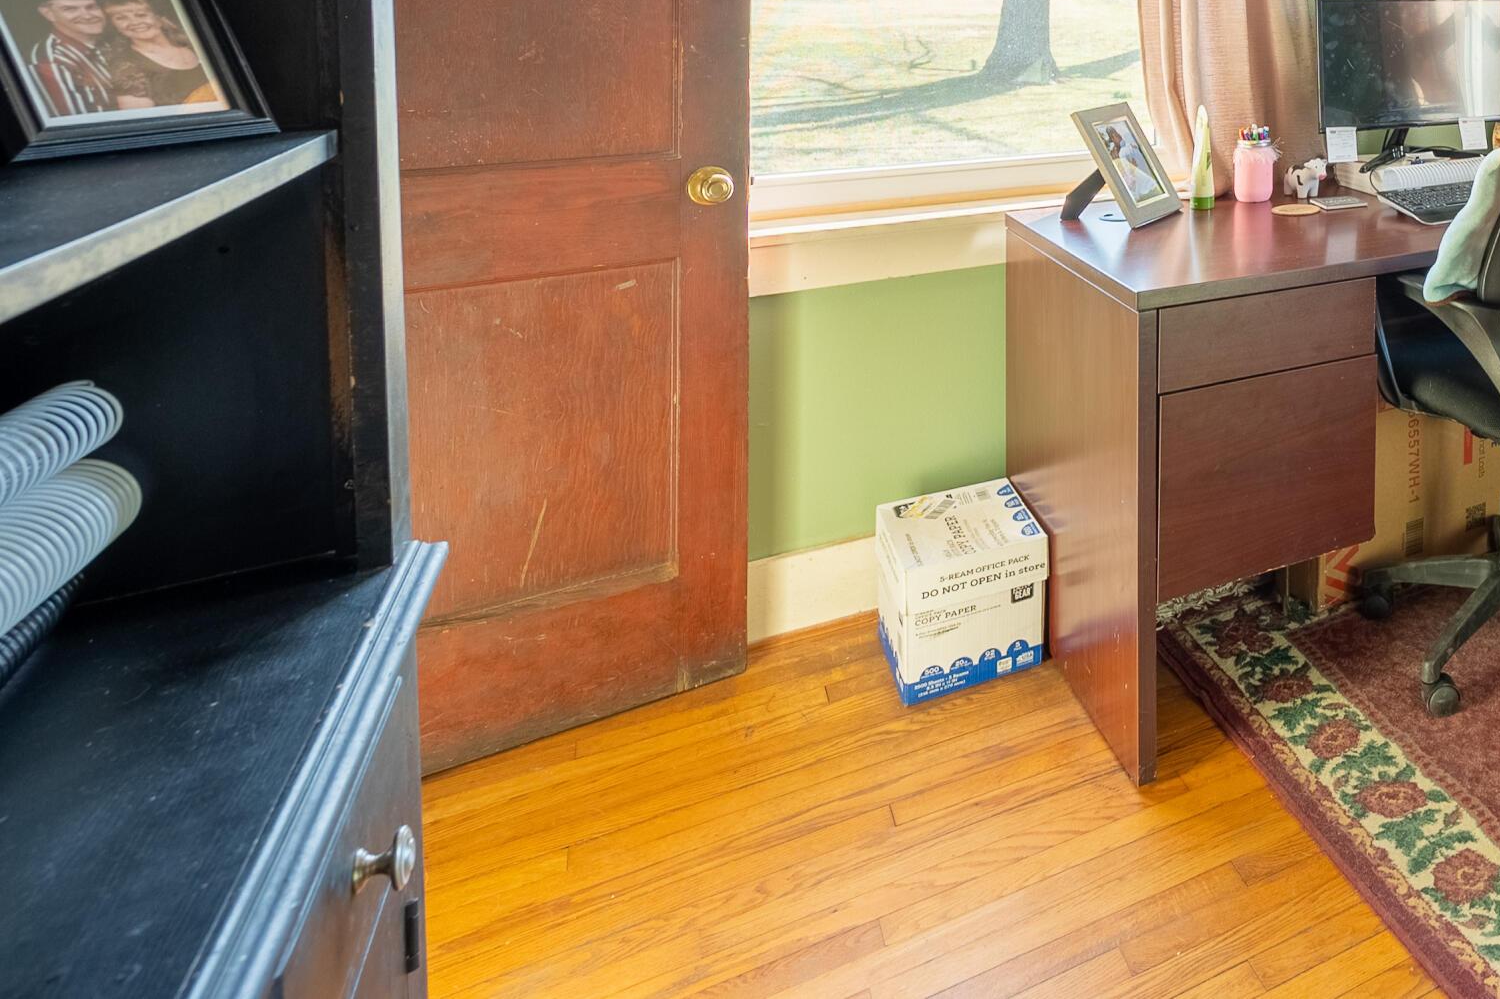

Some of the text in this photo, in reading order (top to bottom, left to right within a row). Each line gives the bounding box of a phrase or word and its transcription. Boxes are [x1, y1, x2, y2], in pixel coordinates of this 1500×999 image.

[921, 589, 939, 600] DO
[942, 582, 967, 595] NOT
[970, 573, 1002, 587] OPEN
[1004, 569, 1016, 579] in
[1018, 562, 1046, 575] store
[939, 554, 1030, 583] 5-REAM OFFICE PACK
[914, 614, 942, 627] COPY
[945, 604, 977, 619] PAPER
